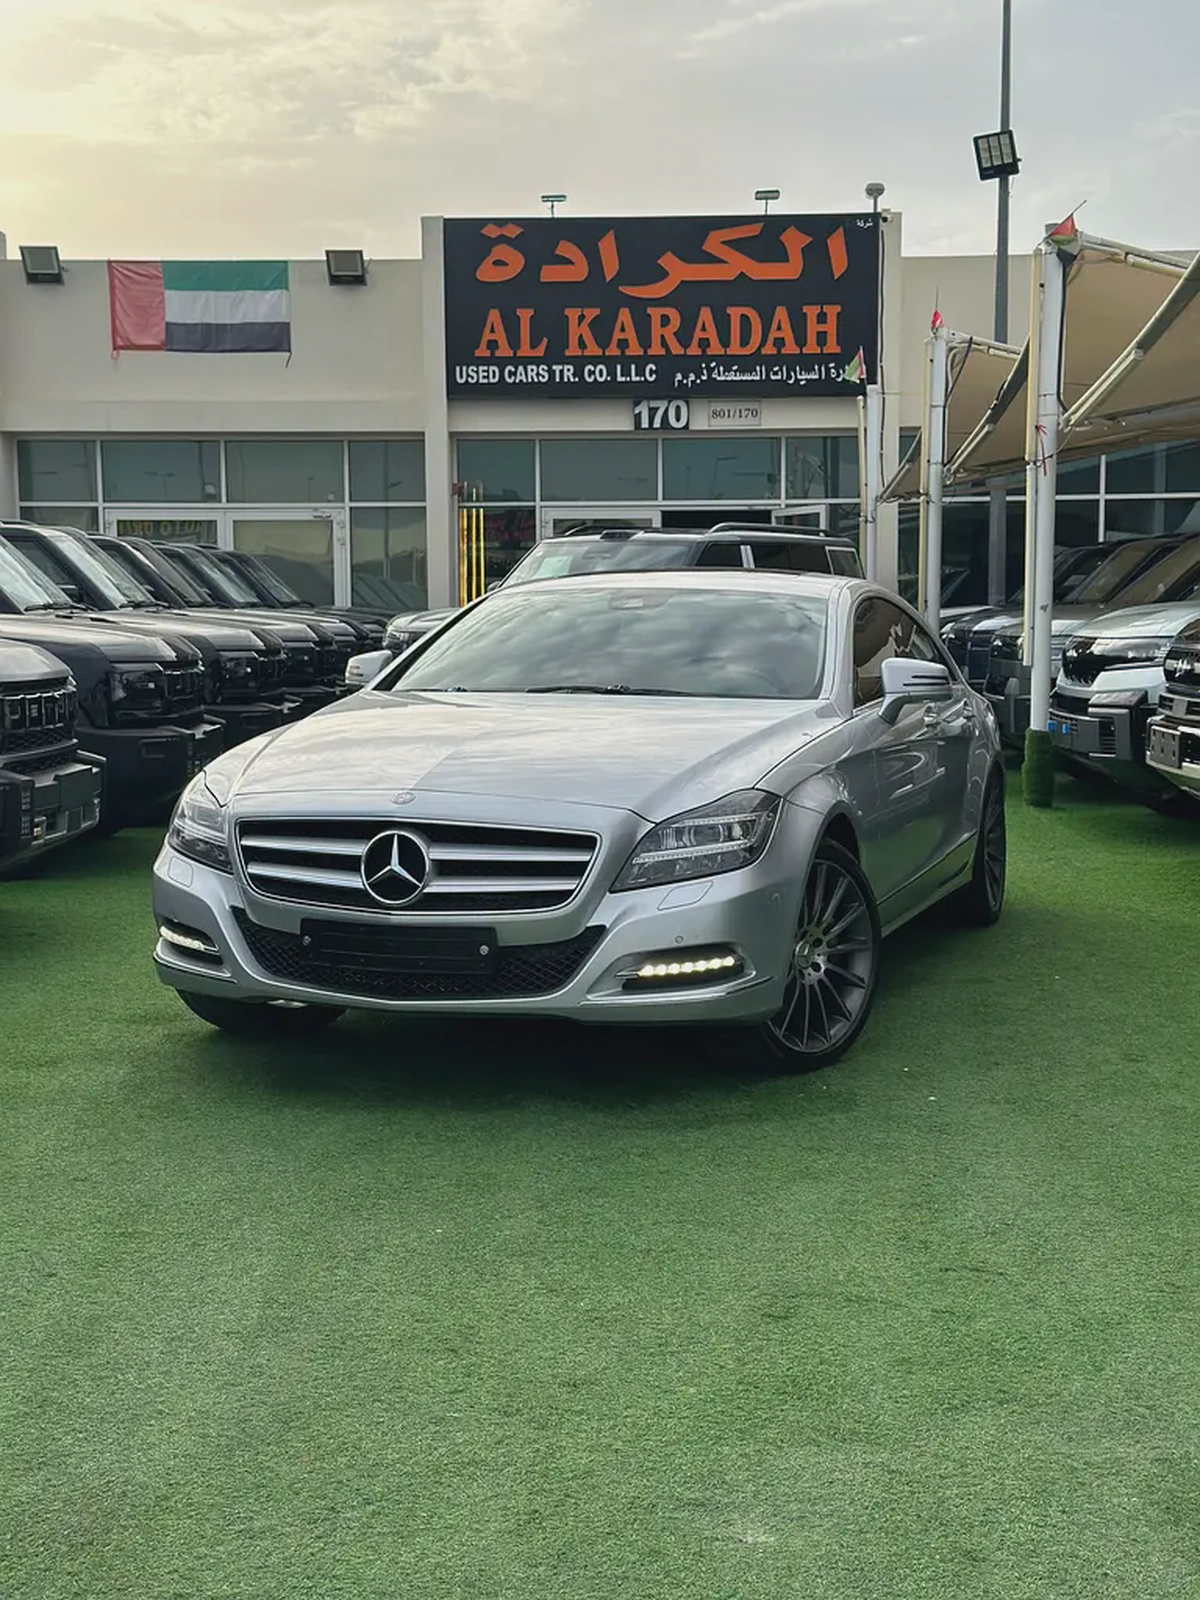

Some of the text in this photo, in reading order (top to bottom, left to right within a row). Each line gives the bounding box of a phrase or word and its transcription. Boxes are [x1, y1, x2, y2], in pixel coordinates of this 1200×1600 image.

[856, 217, 873, 229] شركة
[475, 222, 848, 299] الكرادة
[474, 305, 842, 357] AL KARADAH
[455, 363, 657, 384] USED CARS TR. CO. L.L.C
[711, 361, 766, 381] المستعملة
[769, 363, 825, 385] السيارات
[634, 399, 689, 429] 170
[711, 407, 759, 419] 801/170
